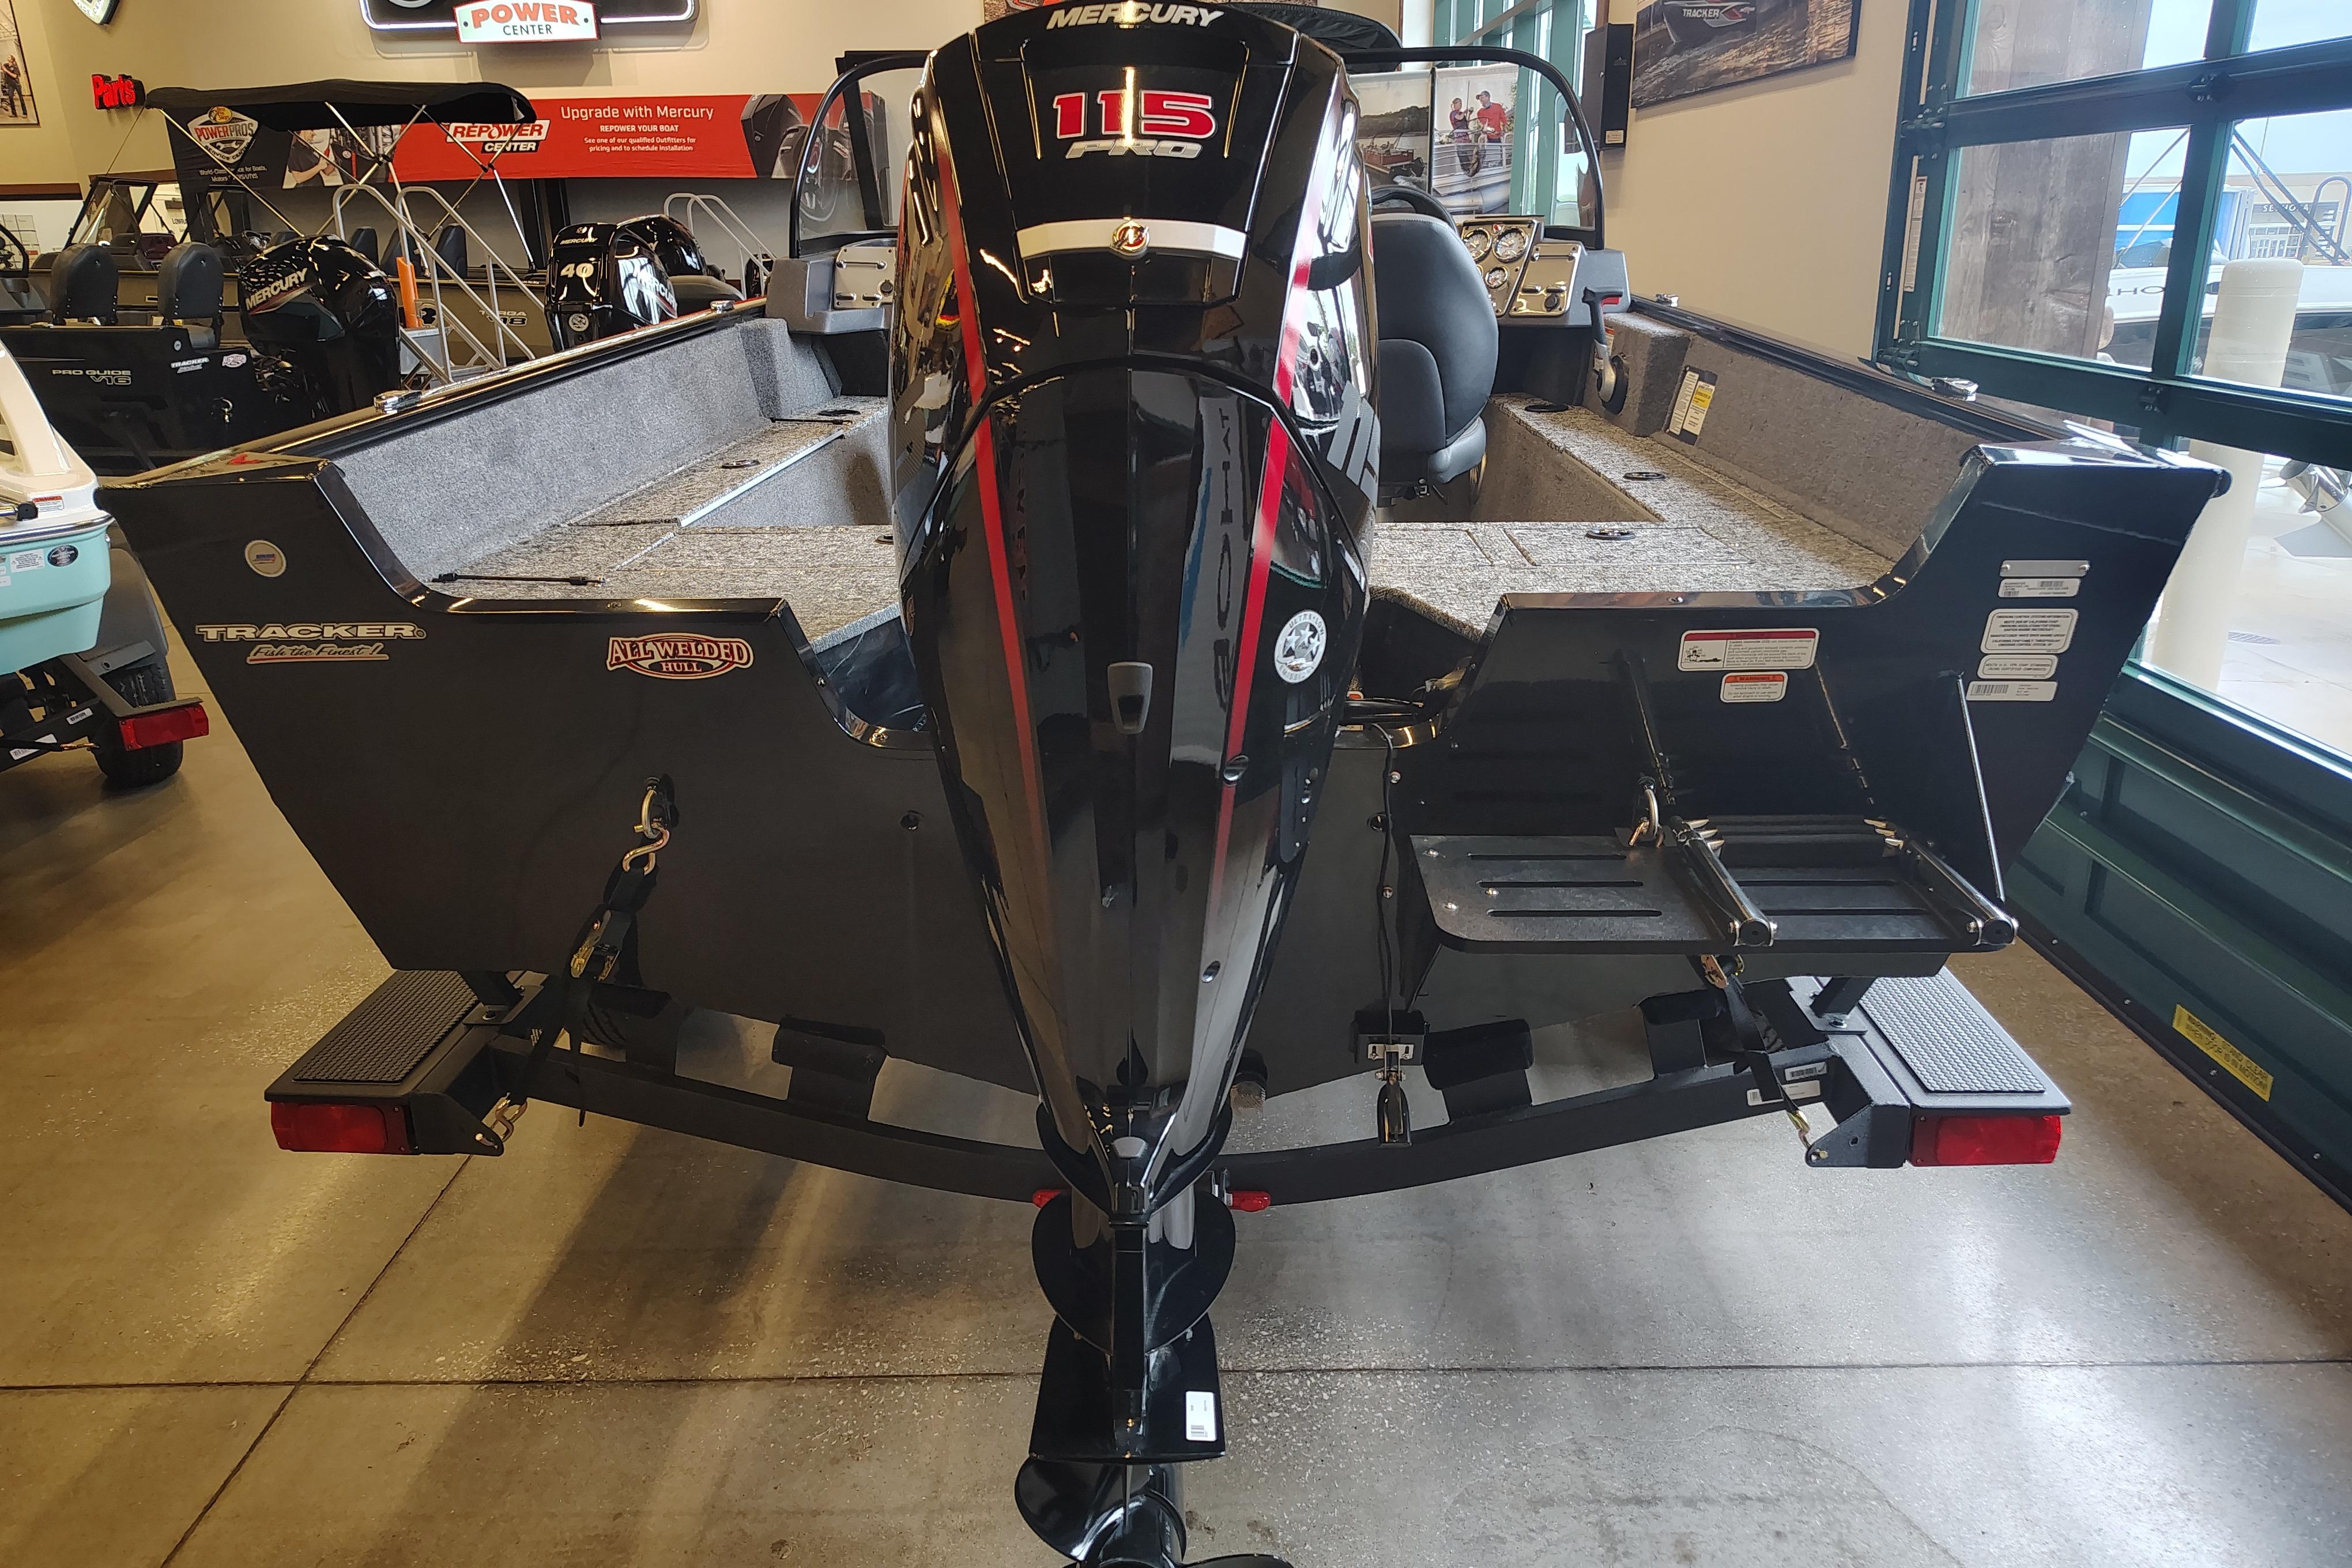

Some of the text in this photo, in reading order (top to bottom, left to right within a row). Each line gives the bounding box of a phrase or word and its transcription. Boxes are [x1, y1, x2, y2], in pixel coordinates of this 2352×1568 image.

[471, 2, 581, 29] POWER
[1046, 1, 1224, 29] MERCURY
[1682, 8, 1720, 19] TRACKER
[503, 24, 553, 36] CENTER
[92, 75, 136, 108] Parts
[560, 105, 714, 120] Upgrade with Mercury
[1053, 88, 1217, 140] 115
[453, 123, 544, 140] REPOWER
[484, 142, 537, 152] CENTER
[628, 137, 655, 145] qualified
[589, 145, 610, 153] pricing
[1065, 139, 1204, 159] PRO
[560, 263, 594, 278] 40
[244, 267, 308, 311] MERCURY
[90, 375, 131, 386] V16
[198, 624, 417, 640] TRACKER
[253, 644, 290, 657] Fish
[291, 644, 314, 657] the
[610, 639, 749, 664] ALL WELDED
[661, 662, 702, 672] HULL
